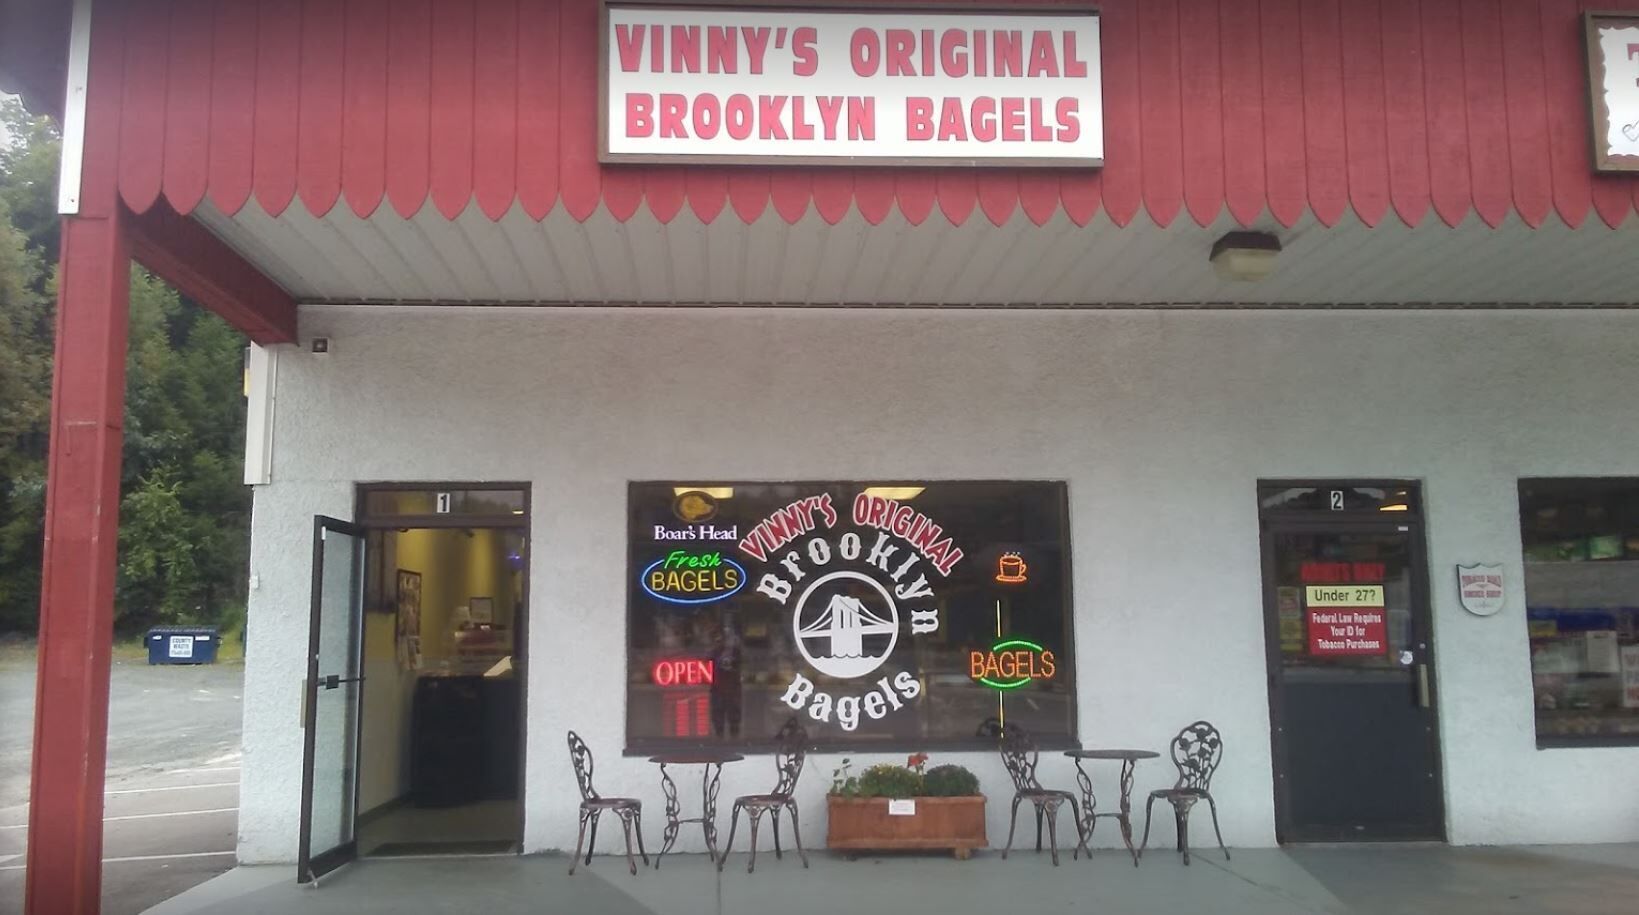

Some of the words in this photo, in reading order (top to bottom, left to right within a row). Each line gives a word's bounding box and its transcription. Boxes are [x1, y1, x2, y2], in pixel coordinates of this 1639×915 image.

[615, 24, 819, 77] VINNY'S
[850, 27, 1088, 79] ORIGINAL
[625, 93, 876, 141] BROOKLYN
[905, 96, 1081, 143] BAGELS
[1332, 492, 1342, 510] 2
[654, 525, 697, 540] Boar's
[699, 525, 738, 540] Head
[738, 492, 837, 563] VINNY'S
[852, 493, 964, 577] ORIGINAL
[664, 550, 722, 569] Fresh
[651, 569, 738, 592] BAGELS
[756, 531, 940, 636] Brooklyn
[1314, 589, 1350, 601] Under
[1356, 588, 1377, 601] 27?
[1312, 612, 1338, 624] Federal
[1338, 613, 1352, 624] Law
[1353, 612, 1382, 625] Requires
[1330, 625, 1346, 636] Your
[1346, 625, 1354, 636] ID
[1355, 625, 1366, 636] for
[1317, 638, 1346, 649] Tobacco
[1346, 638, 1380, 649] Purchases
[655, 660, 714, 685] OPEN
[970, 650, 1056, 679] BAGELS
[780, 671, 921, 732] Bagels
